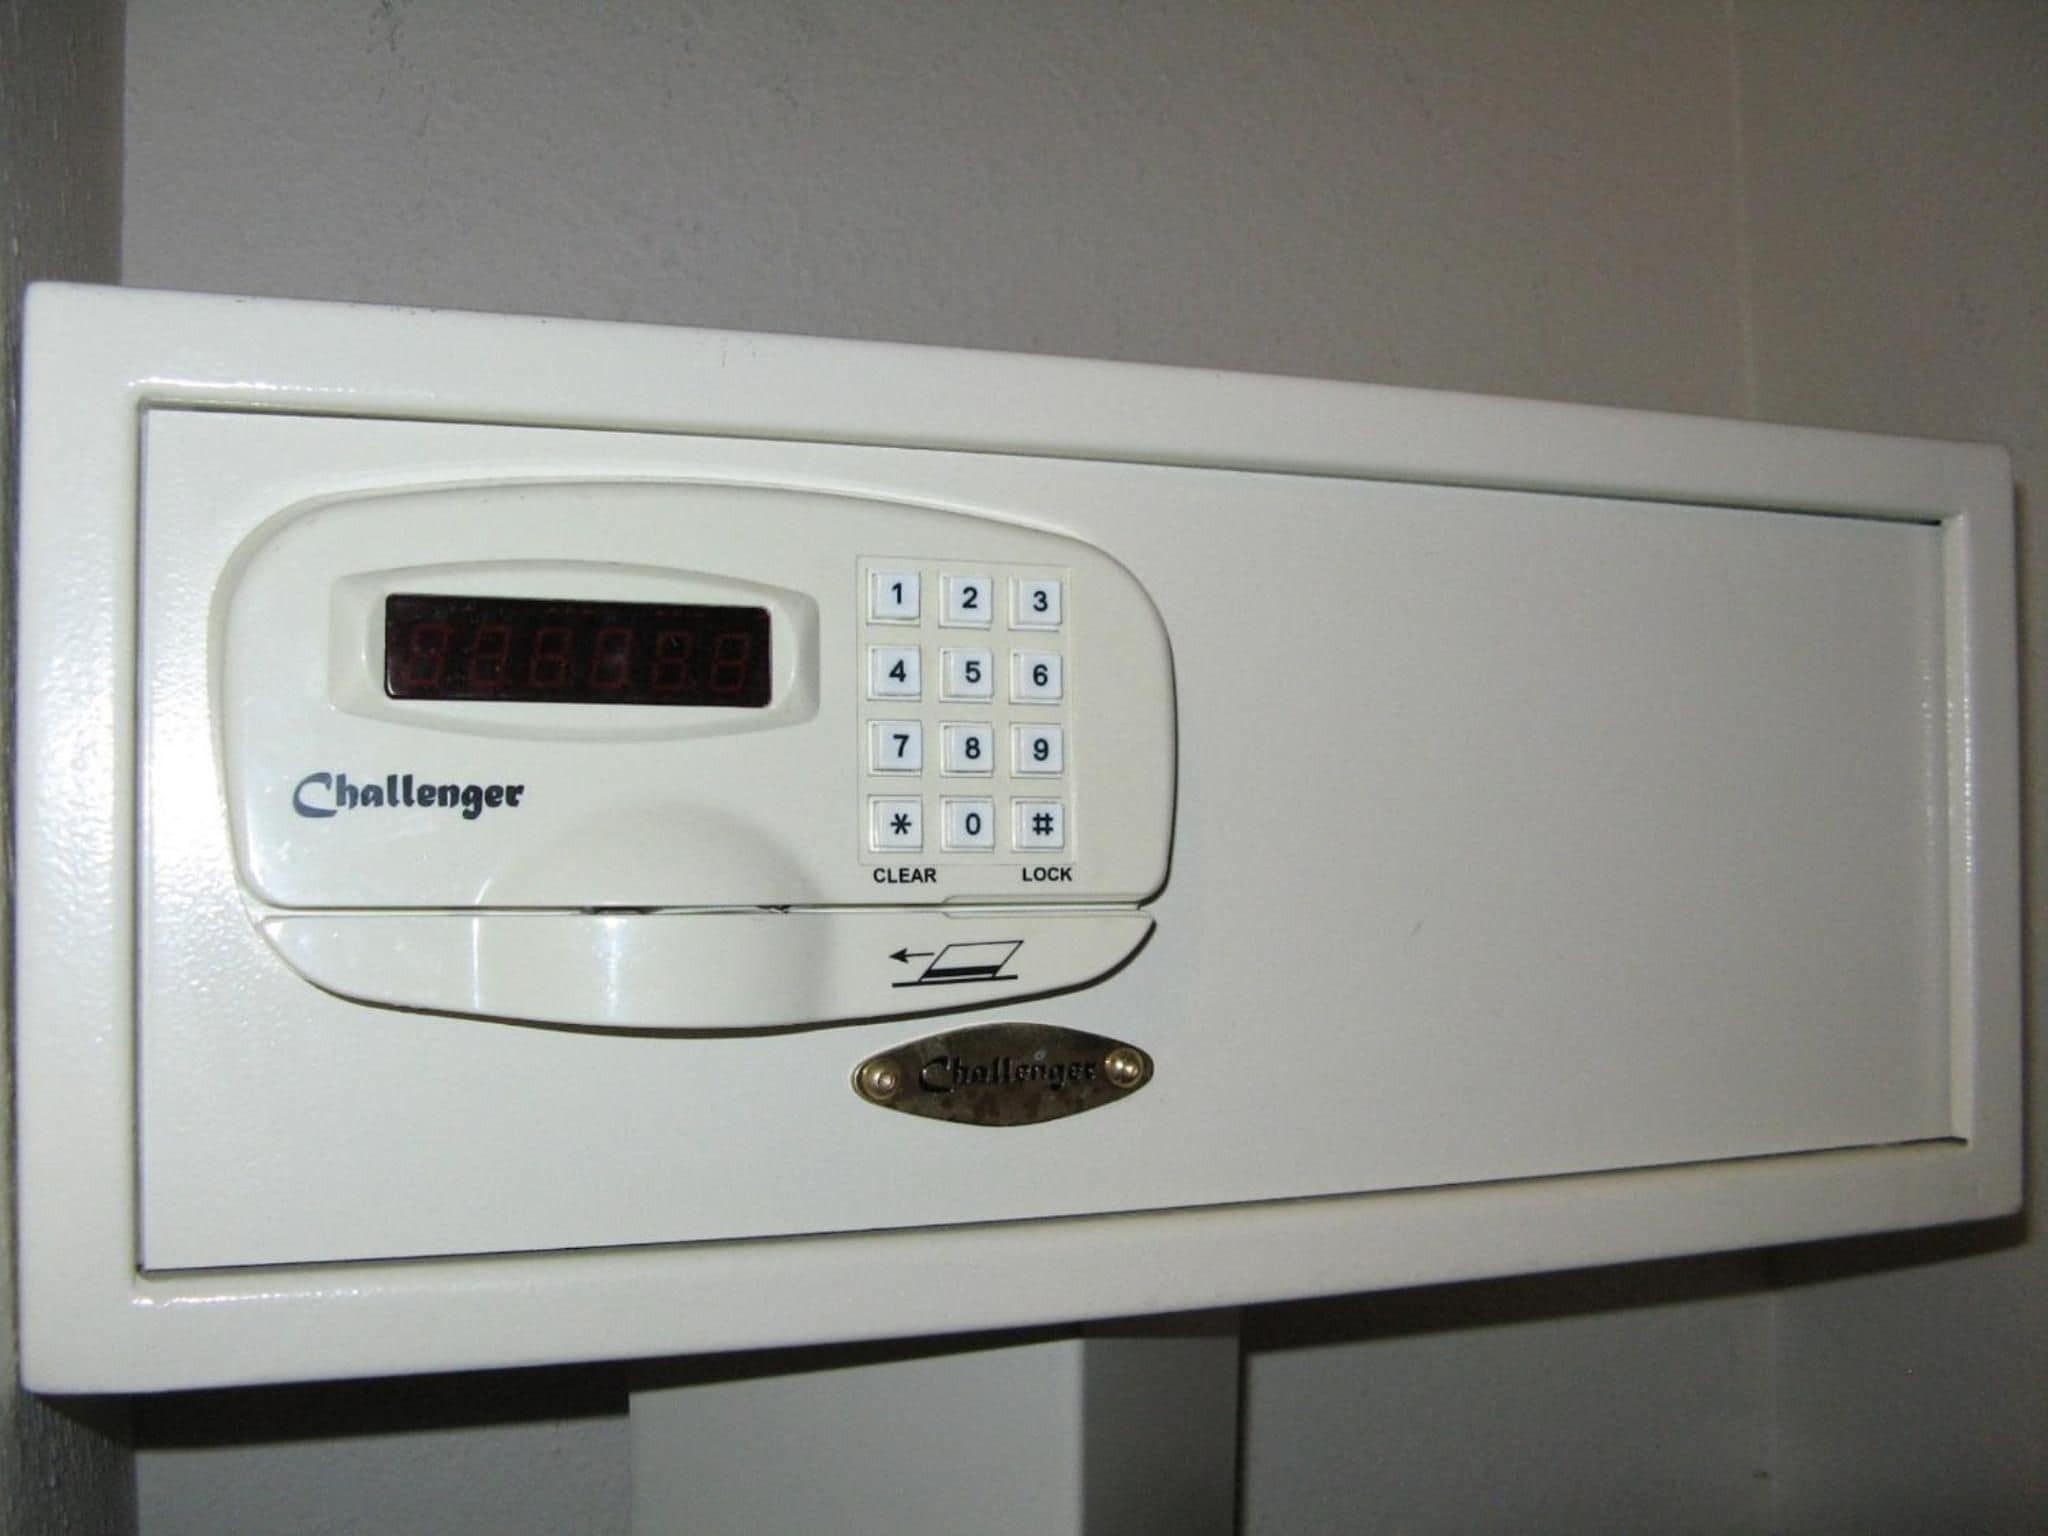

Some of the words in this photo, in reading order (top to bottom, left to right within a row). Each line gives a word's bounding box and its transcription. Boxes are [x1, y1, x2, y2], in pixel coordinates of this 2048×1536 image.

[891, 583, 902, 604] 1
[962, 586, 978, 609] 2
[1032, 590, 1048, 612] 3
[889, 659, 906, 682] 4
[965, 661, 981, 683] 5
[1032, 664, 1048, 687] 6
[893, 734, 909, 758] 7
[965, 737, 981, 760] 8
[1033, 738, 1049, 761] 9
[292, 772, 524, 820] Challenger
[965, 813, 981, 836] 0
[1032, 812, 1053, 836] #
[873, 867, 937, 883] CLEAR
[1022, 867, 1073, 882] LOCK
[919, 1056, 1097, 1093] Challenger
